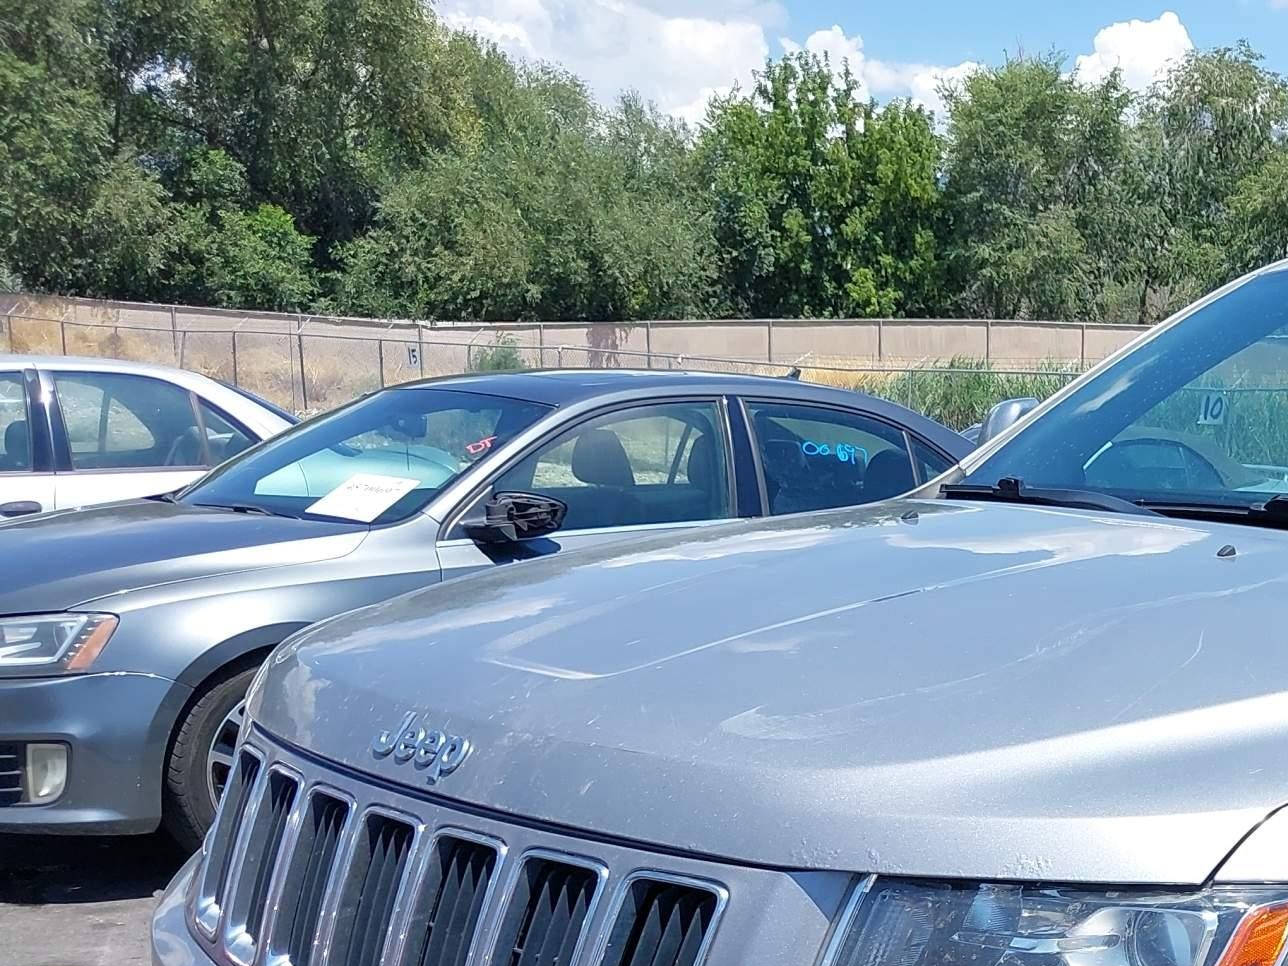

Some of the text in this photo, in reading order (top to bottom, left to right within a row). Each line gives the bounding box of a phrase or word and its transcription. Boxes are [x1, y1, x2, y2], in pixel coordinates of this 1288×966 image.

[407, 347, 418, 365] 15
[1203, 396, 1223, 420] 10
[371, 710, 474, 785] Jeep
